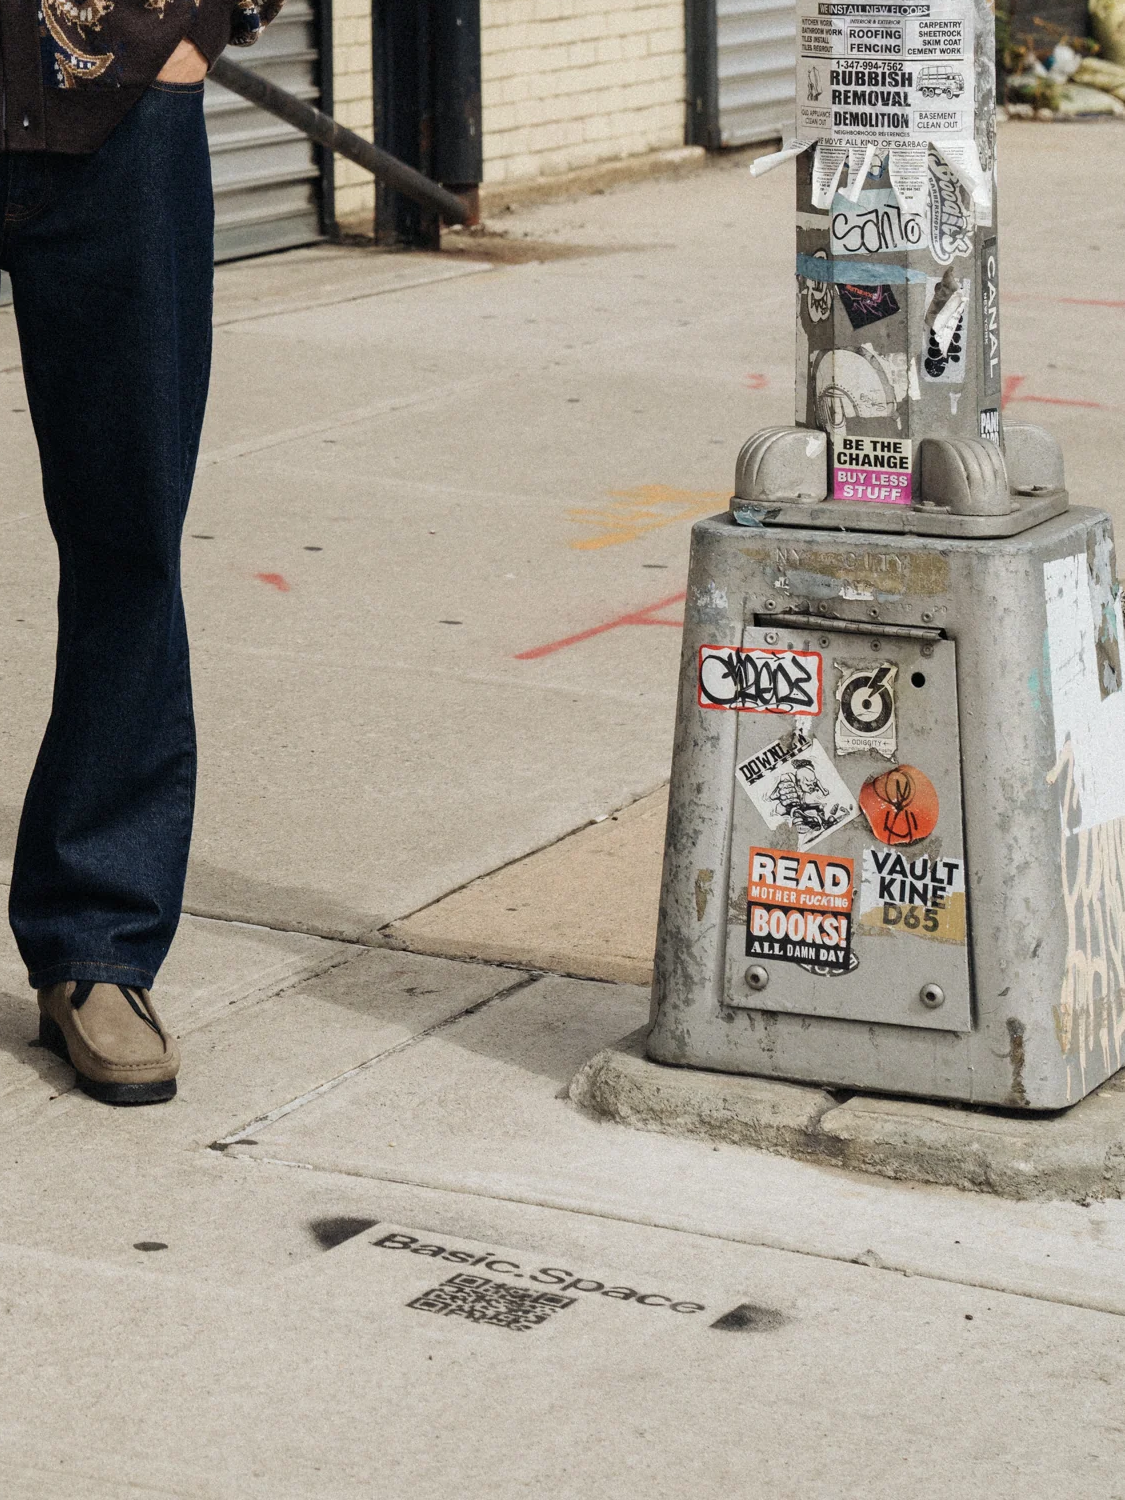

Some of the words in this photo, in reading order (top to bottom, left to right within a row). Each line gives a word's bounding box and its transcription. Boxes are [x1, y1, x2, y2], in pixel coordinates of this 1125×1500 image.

[820, 4, 828, 14] WE
[829, 4, 863, 14] INSTALL
[866, 5, 888, 14] NEW
[891, 5, 928, 15] FLOORS
[802, 27, 824, 35] BATHROOM
[825, 28, 842, 36] WORK
[820, 19, 832, 27] WORK
[919, 21, 962, 29] CARPENTRY
[814, 36, 829, 44] INSTALL
[849, 29, 902, 40] ROOFING
[850, 43, 901, 54] FENCING
[836, 61, 903, 71] 1-347-994-7562
[830, 70, 913, 88] RUBBISH
[832, 89, 911, 107] REMOVAL
[834, 111, 909, 129] DEMOLITION
[918, 112, 957, 120] BASEMENT
[917, 121, 941, 129] CLEAN
[987, 255, 999, 378] CANAL
[843, 438, 864, 451] BE
[870, 440, 902, 453] THE
[837, 452, 909, 470] CHANGE
[837, 471, 867, 485] BUY
[872, 473, 908, 487] LESS
[843, 485, 902, 501] STUFF
[751, 853, 850, 896] READ
[871, 850, 959, 886] VAULT
[751, 886, 796, 903] MOTHER
[800, 893, 848, 908] FUCKING
[879, 876, 946, 909] KINE
[883, 902, 940, 932] D65
[750, 906, 848, 948] BOOKS!
[751, 941, 783, 955] ALL
[787, 944, 815, 960] DAMN
[819, 949, 845, 963] DAY
[372, 1232, 706, 1314] Basic.Space
